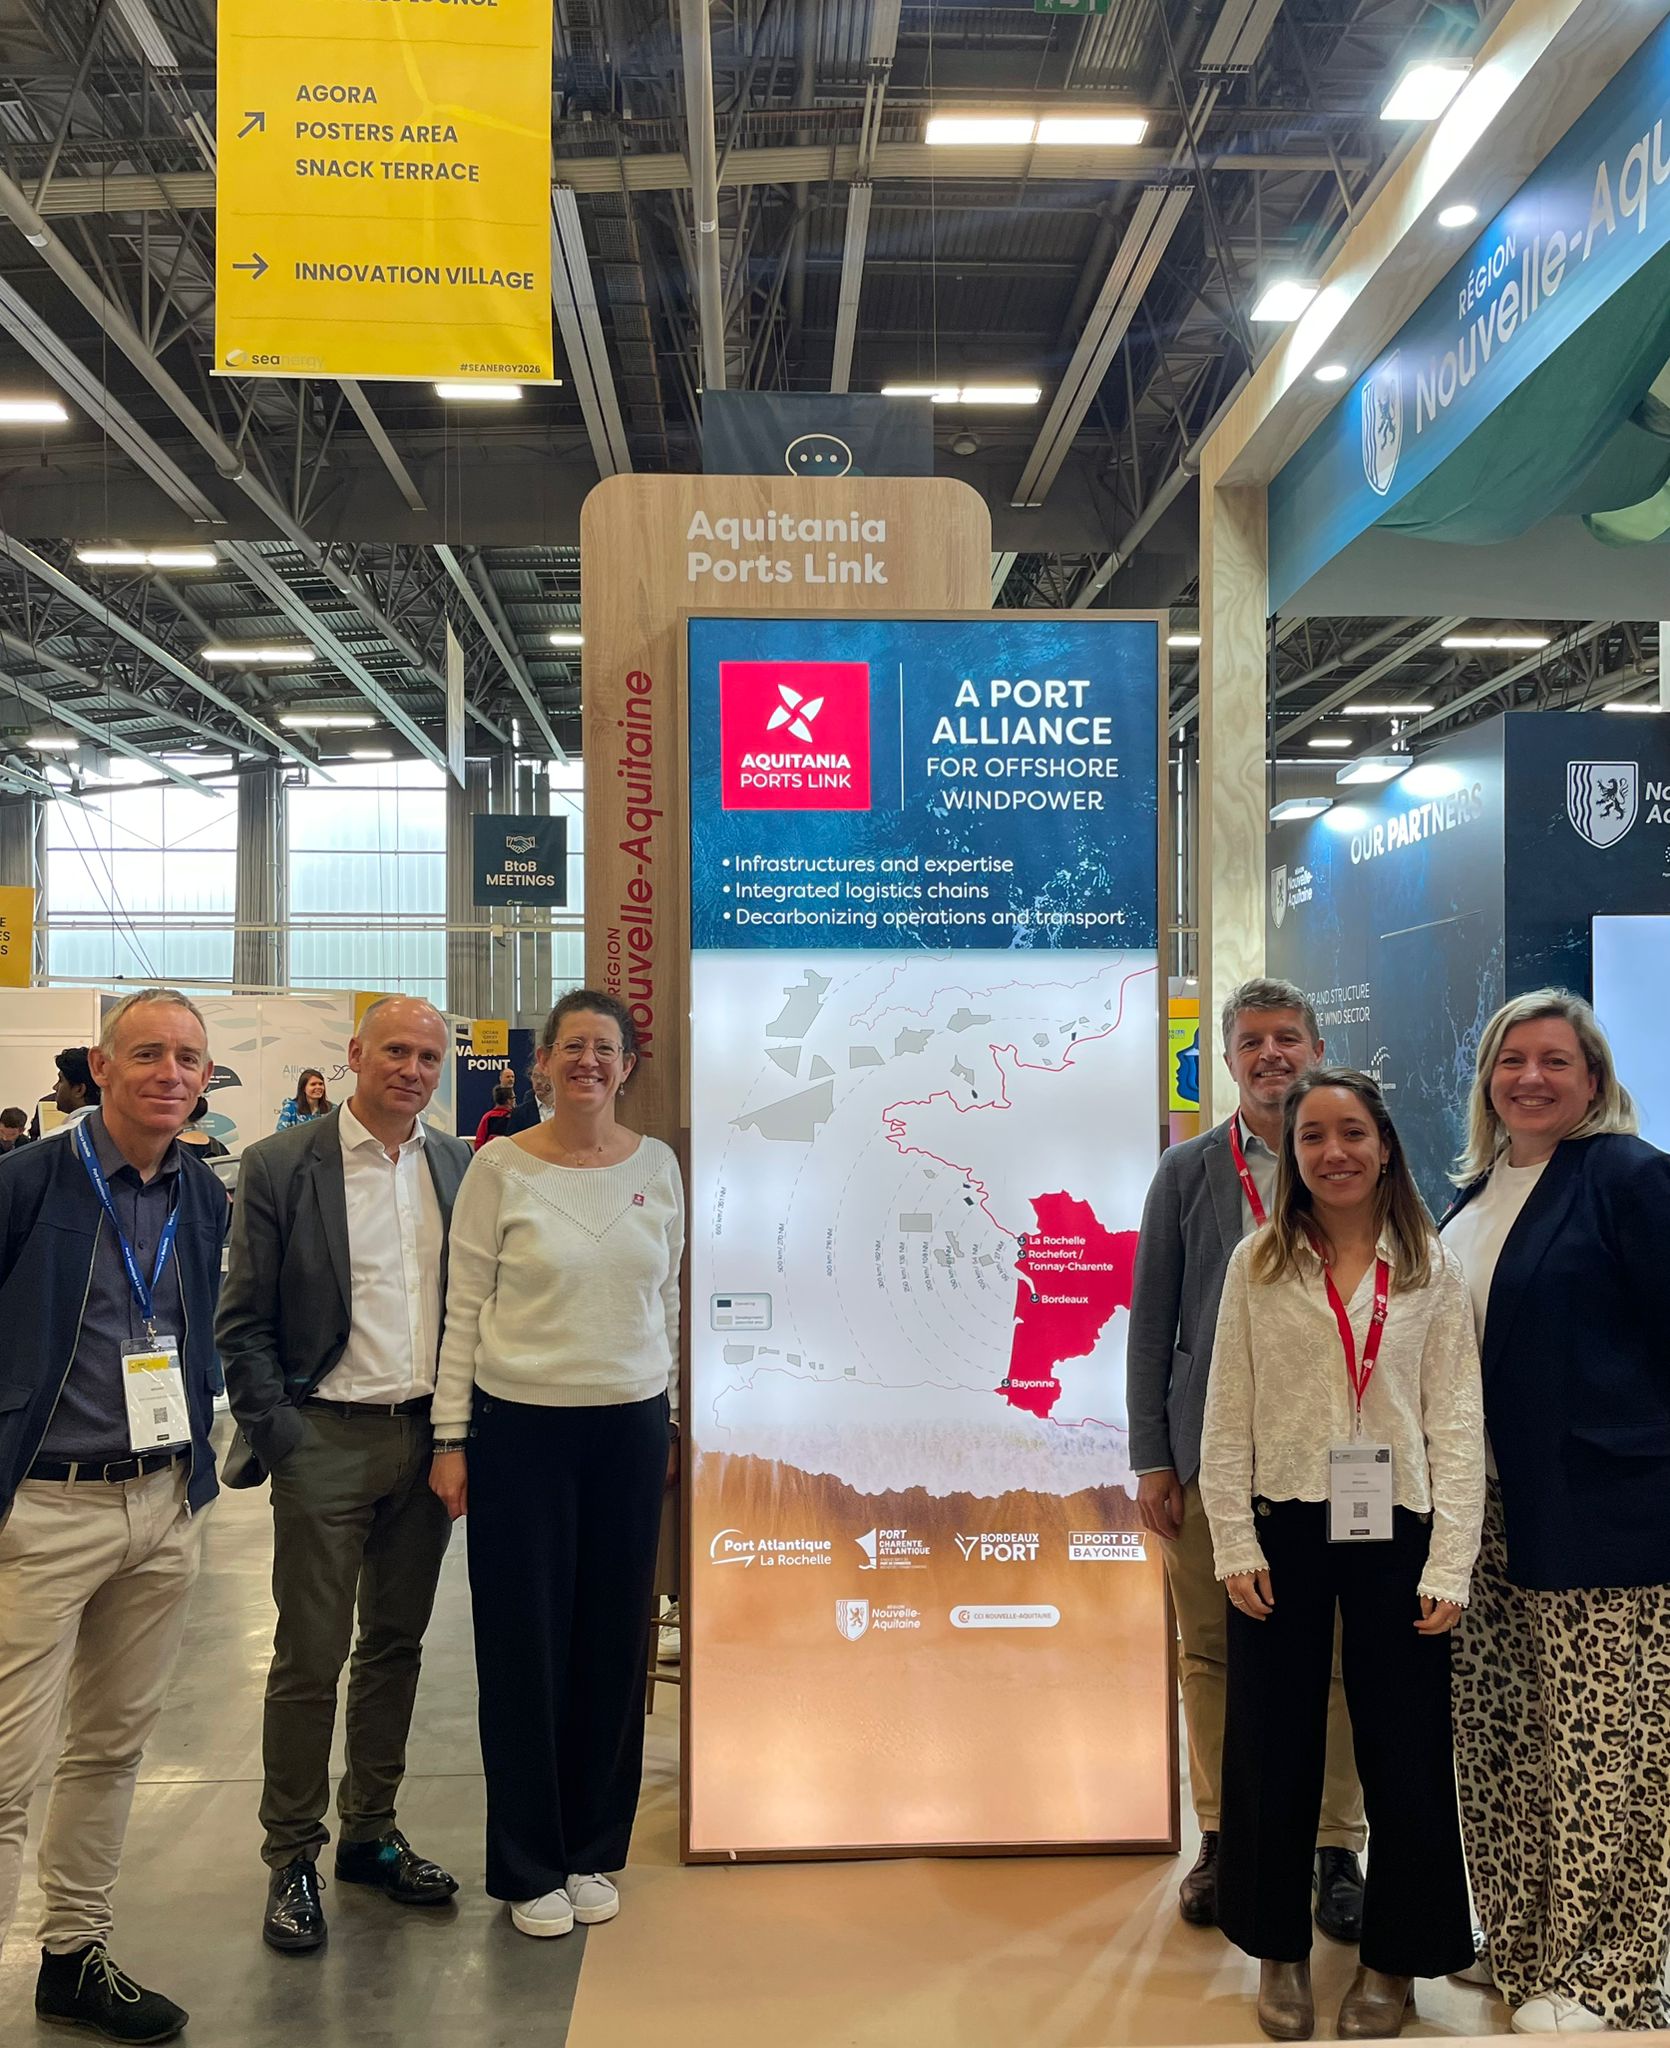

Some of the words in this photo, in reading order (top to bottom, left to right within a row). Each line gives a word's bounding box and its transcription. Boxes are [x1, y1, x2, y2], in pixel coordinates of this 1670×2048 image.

[296, 85, 377, 104] AGORA
[295, 121, 394, 143] POSTERS
[400, 125, 459, 143] AREA
[295, 158, 374, 179] SNACK
[380, 161, 480, 182] TERRACE
[295, 262, 440, 285] INNOVATION
[445, 266, 535, 290] VILLAGE
[1458, 233, 1517, 320] RÉGION
[460, 363, 541, 374] #SEANERGY2026
[686, 510, 886, 550] Aquitania
[687, 553, 793, 584] Ports
[804, 552, 889, 585] Link
[954, 680, 979, 708] A
[990, 680, 1090, 708] PORT
[931, 716, 1113, 745] ALLIANCE
[740, 753, 851, 769] AQUITANIA
[926, 758, 978, 778] FOR
[984, 758, 1119, 779] OFFSHORE
[740, 773, 804, 788] PORTS
[808, 773, 852, 789] LINK
[942, 790, 1105, 811] WINDPOWER
[1350, 823, 1385, 865] OUR
[1387, 782, 1483, 852] PARTNERS
[504, 861, 537, 872] BtoB
[734, 855, 876, 873] Infrastructures
[881, 856, 920, 873] and
[925, 856, 1014, 877] expertise
[486, 874, 555, 887] MEETINGS
[735, 882, 840, 902] Integrated
[845, 882, 922, 902] logistics
[927, 882, 990, 900] chains
[736, 908, 877, 929] Decarbonizing
[882, 909, 985, 930] operations
[990, 909, 1030, 926] and
[1035, 910, 1125, 930] transport
[603, 927, 621, 996] RÉGION
[1331, 983, 1370, 1004] STRUCTURE
[1325, 1010, 1342, 1026] WIND
[1343, 1006, 1371, 1024] SECTOR
[468, 1059, 511, 1071] POINT
[1029, 1237, 1041, 1245] La
[1043, 1236, 1086, 1246] Rochelle
[1028, 1249, 1077, 1259] Rochefort
[1028, 1262, 1113, 1272] Tonnay-Charente
[1041, 1294, 1089, 1304] Bordeaux
[1011, 1378, 1055, 1391] Bayonne
[879, 1529, 907, 1540] PORT
[980, 1533, 1039, 1543] BORDEAUX
[1084, 1534, 1117, 1545] PORT
[1122, 1534, 1139, 1545] DE
[724, 1539, 754, 1552] Port
[757, 1538, 832, 1553] Atlantique
[879, 1540, 923, 1548] CHARENTE
[879, 1547, 930, 1555] ATLANTIQUE
[760, 1555, 774, 1566] La
[777, 1554, 832, 1566] Rochelle
[980, 1543, 1040, 1562] PORT
[1073, 1547, 1139, 1558] BAYONNE
[872, 1608, 921, 1618] Nouvelle-
[872, 1620, 921, 1631] Aquitaine
